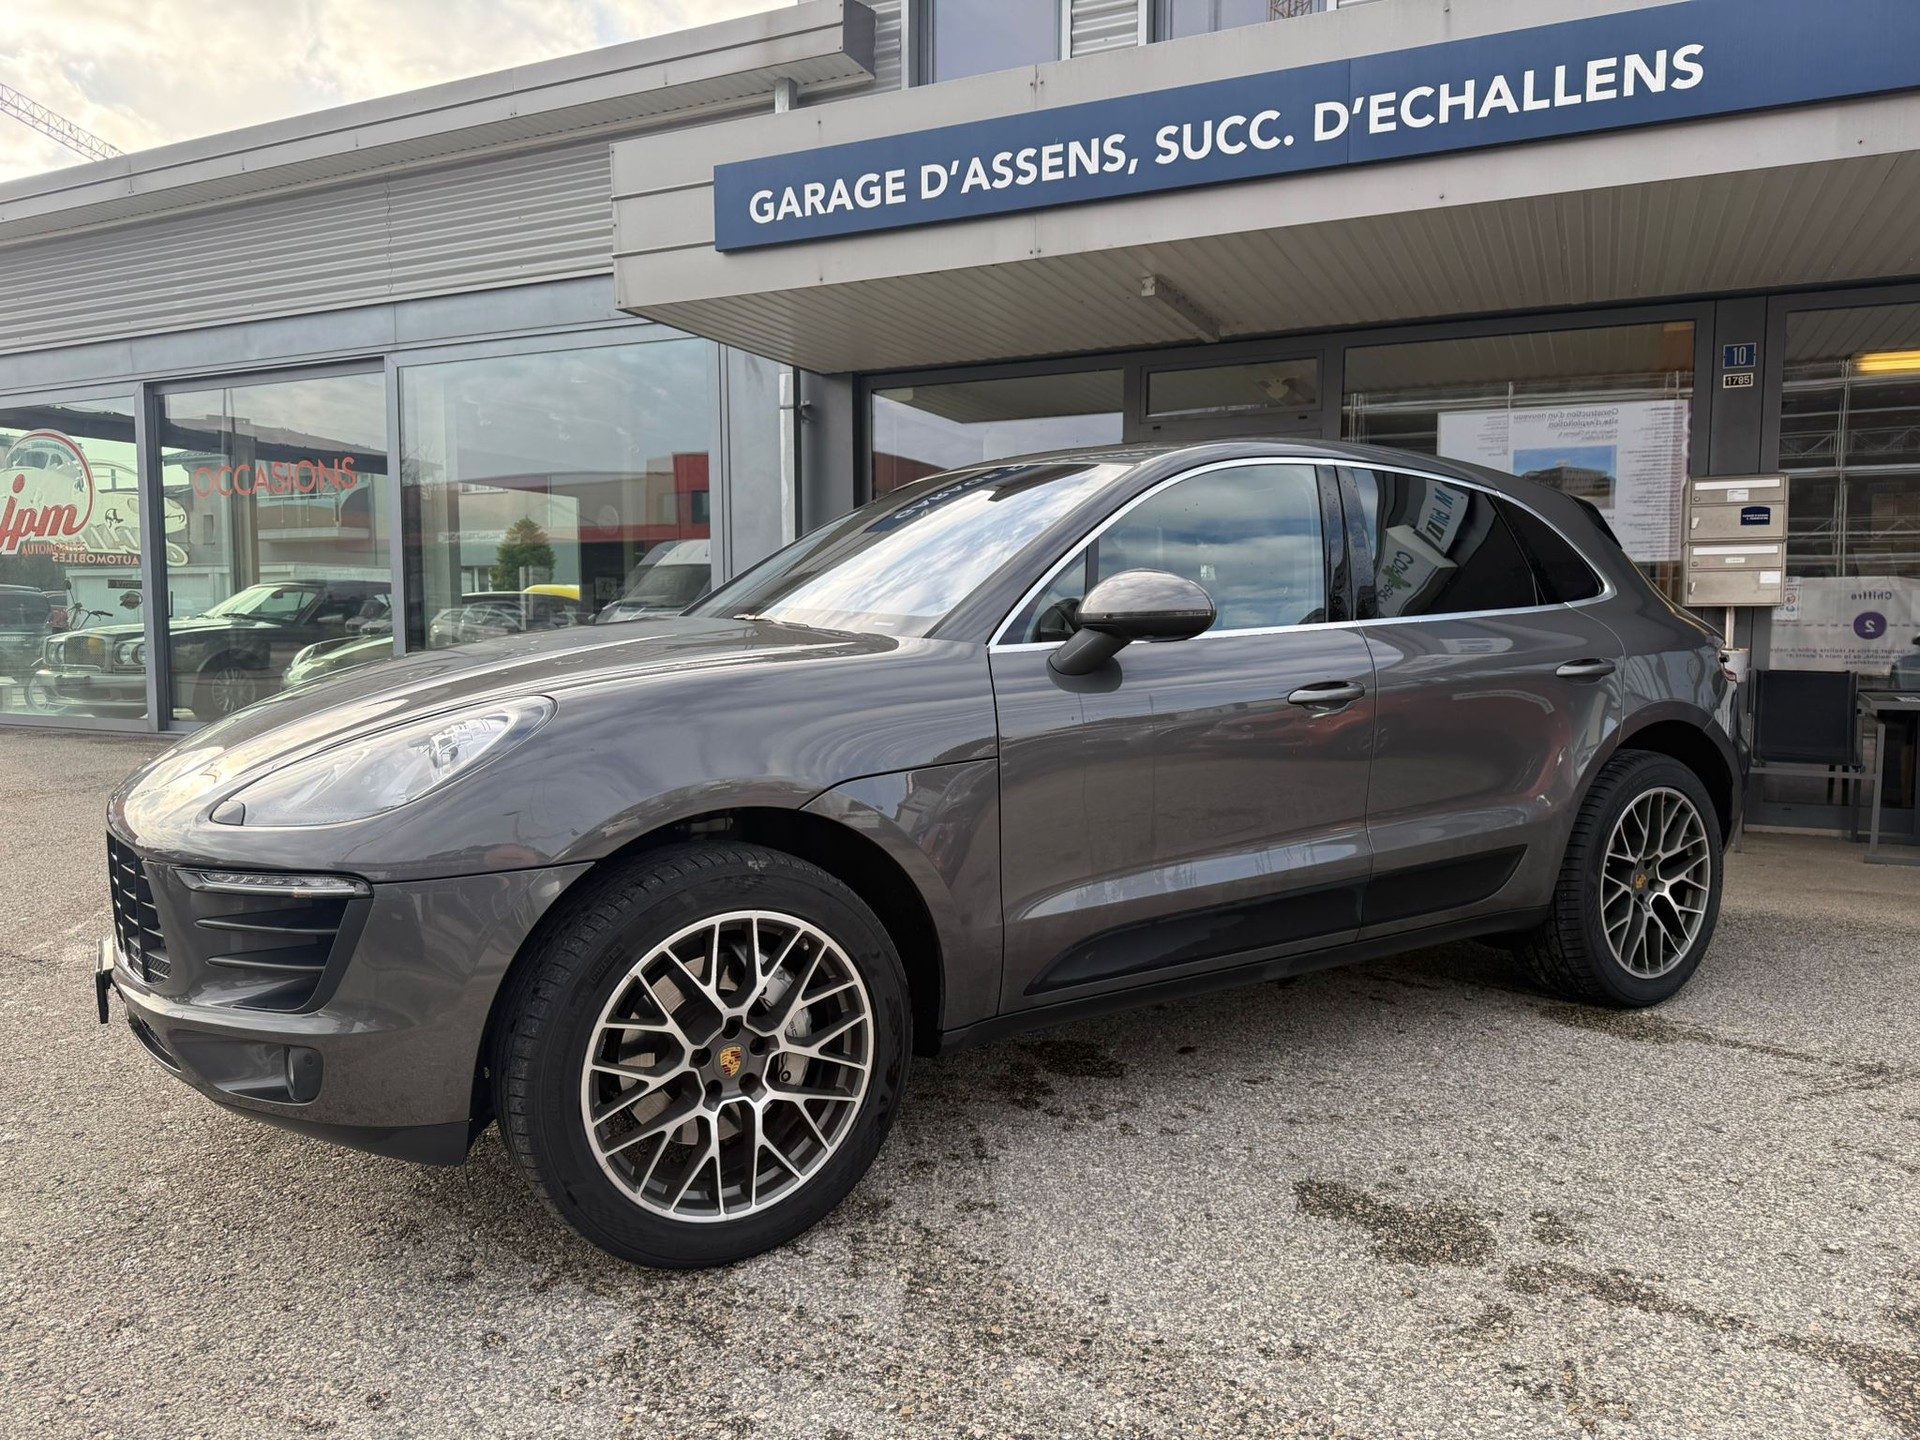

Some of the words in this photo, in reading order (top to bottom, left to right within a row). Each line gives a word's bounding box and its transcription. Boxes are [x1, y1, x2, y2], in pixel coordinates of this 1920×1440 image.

[748, 169, 907, 224] GARAGE
[920, 133, 1139, 200] D'ASSENS,
[1154, 109, 1294, 165] SUCC.
[1313, 43, 1705, 142] D'ECHALLENS
[1732, 346, 1747, 365] 10
[1726, 375, 1751, 385] 1785
[193, 456, 358, 498] OCCASIONS
[0, 473, 82, 550] jpm
